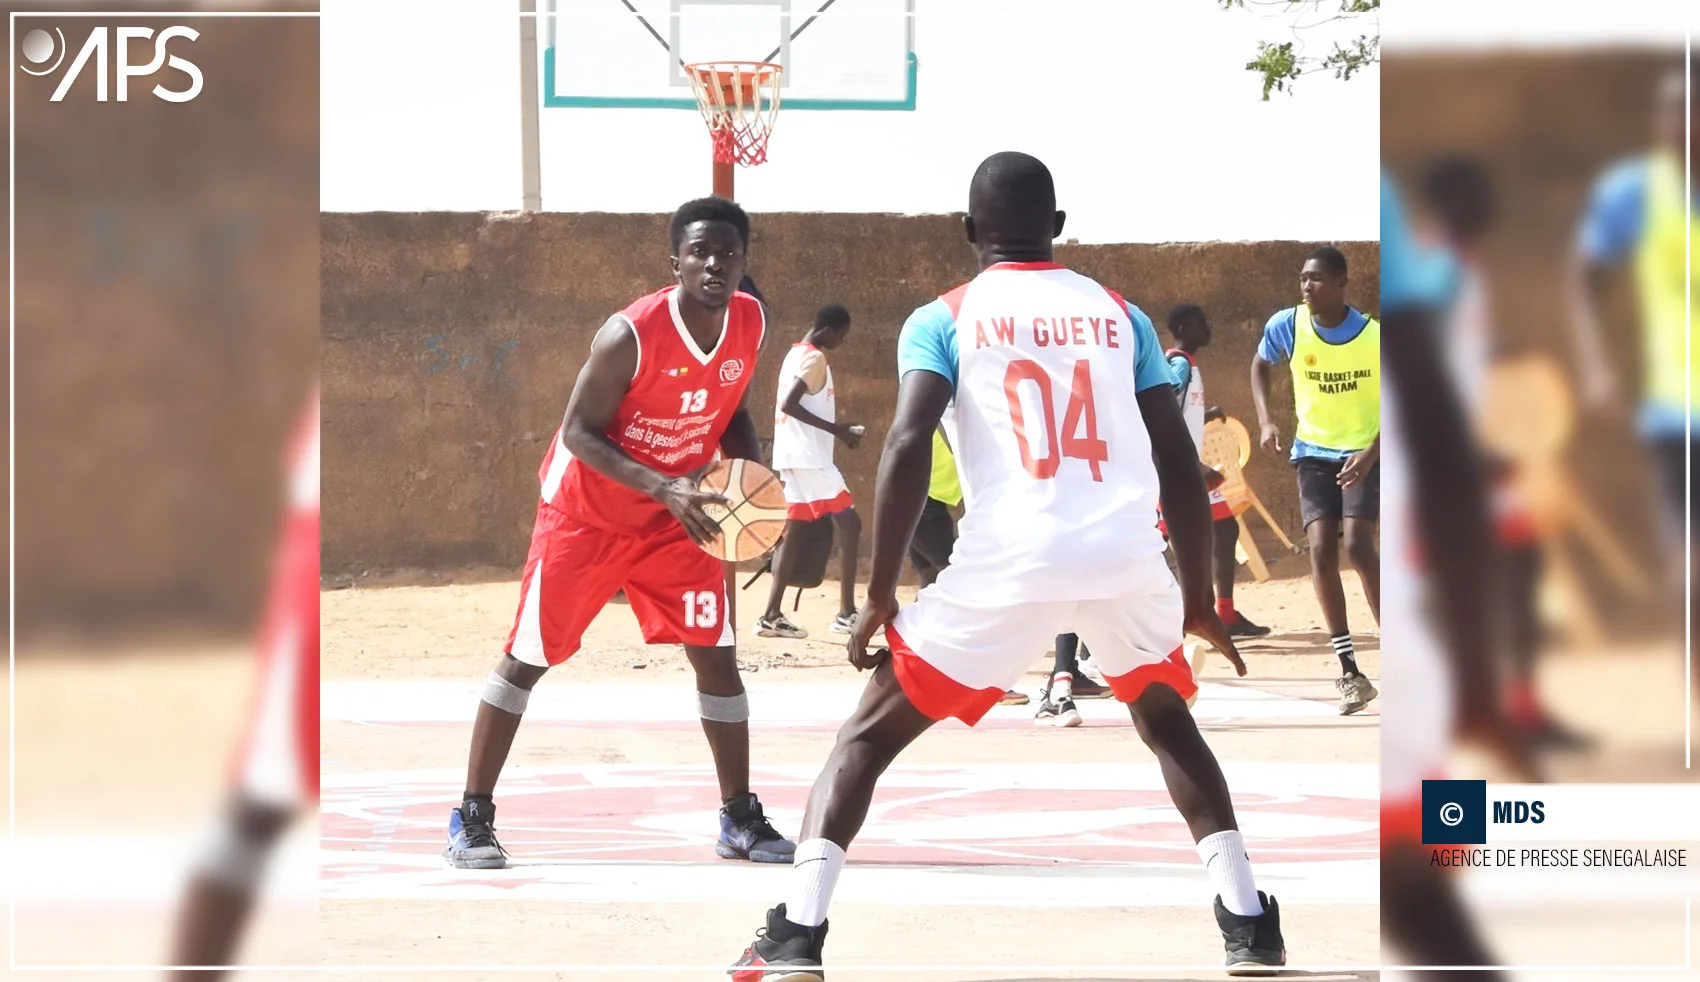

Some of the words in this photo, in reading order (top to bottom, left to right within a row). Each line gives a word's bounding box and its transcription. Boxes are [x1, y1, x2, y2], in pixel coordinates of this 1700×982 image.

[976, 316, 1014, 349] AW
[1032, 316, 1119, 349] GUEYE
[679, 388, 708, 415] 13
[1318, 380, 1357, 394] MATAM
[624, 422, 645, 441] dans
[643, 426, 654, 444] la
[1003, 359, 1108, 482] 04
[681, 590, 718, 629] 13
